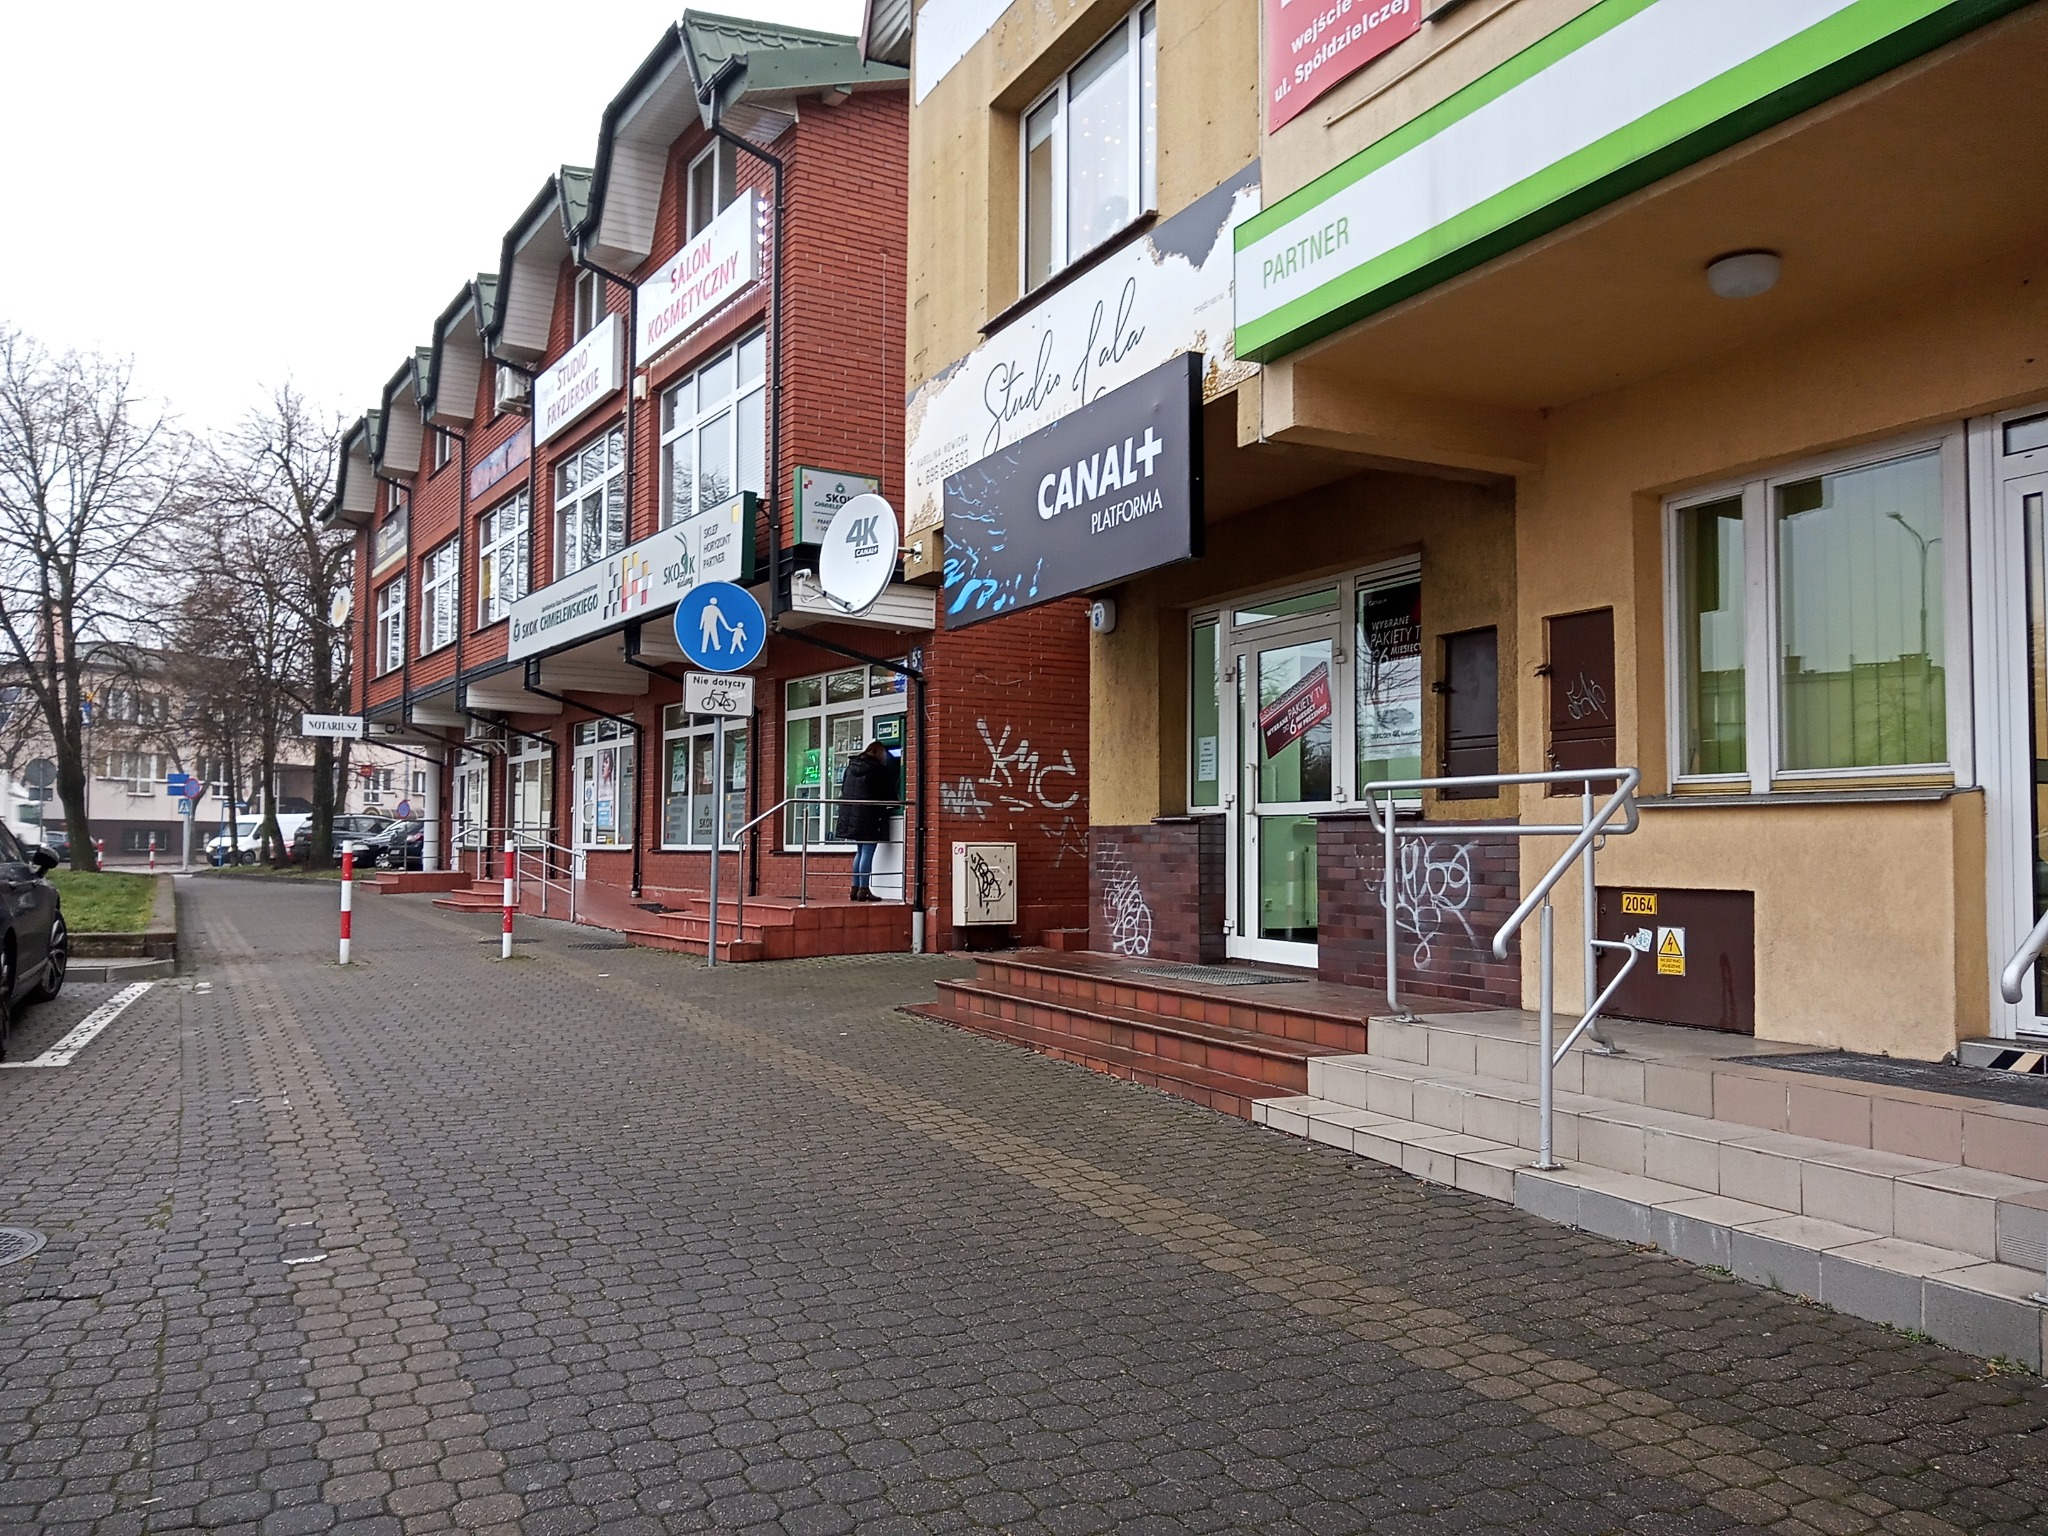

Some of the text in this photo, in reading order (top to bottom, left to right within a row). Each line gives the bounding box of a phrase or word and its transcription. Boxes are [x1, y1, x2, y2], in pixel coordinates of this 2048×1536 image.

[1291, 0, 1352, 54] wejście
[1274, 0, 1411, 103] ul. Spółdzielczej
[670, 237, 711, 294] SALON
[1263, 216, 1349, 289] PARTNER
[647, 250, 739, 346] KOSMETYCZNY
[557, 348, 588, 391] STUDIO
[547, 366, 599, 427] FRYZJERSKIE
[983, 328, 1061, 457] Studio
[1036, 426, 1163, 520] CANAL+
[845, 514, 879, 547] 4K
[1090, 488, 1163, 534] PLATFORMA
[855, 545, 879, 558] CANAL+
[521, 618, 539, 639] SKOK
[540, 593, 599, 631] CHMIELEWSKIEGO
[1370, 626, 1413, 648] PAKIETY
[1371, 615, 1410, 631] WYBRANE
[693, 675, 746, 689] Nie dotyczy
[1287, 689, 1315, 719] PAKIETY
[1315, 683, 1325, 699] TV
[308, 720, 358, 732] NOTARIUSZ
[1289, 717, 1298, 735] 6
[1625, 896, 1653, 912] 2064
